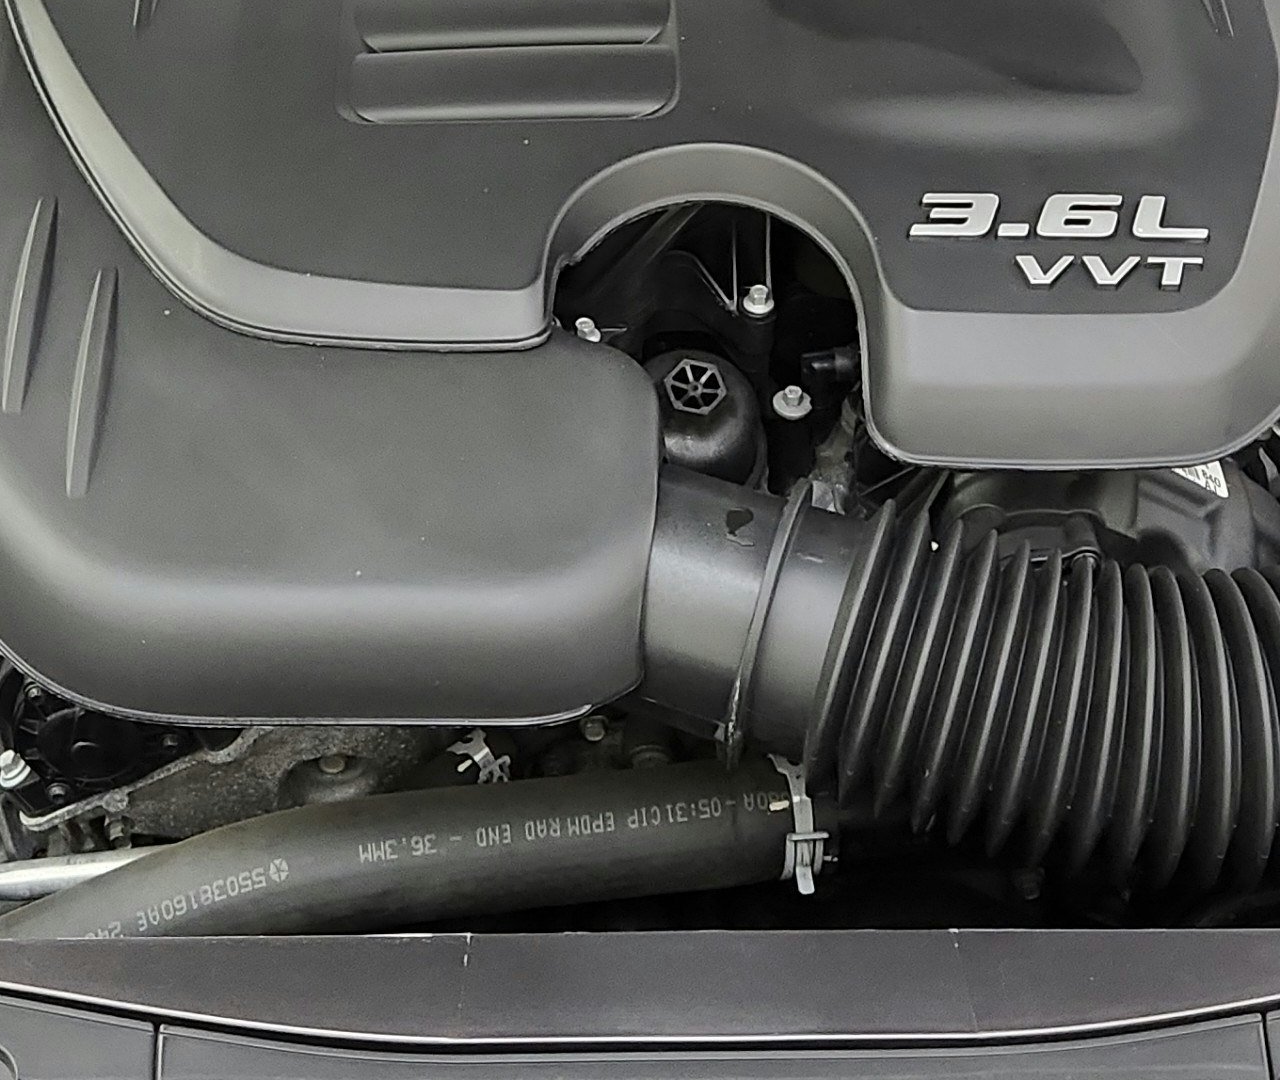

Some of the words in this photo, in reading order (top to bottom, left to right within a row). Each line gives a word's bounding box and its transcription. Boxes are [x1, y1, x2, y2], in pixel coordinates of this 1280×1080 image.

[910, 193, 1209, 240] 3.6L
[1015, 255, 1204, 290] VVT
[476, 825, 511, 847] END
[524, 816, 560, 841] RAD
[566, 811, 614, 837] EPDM
[359, 833, 437, 863] 36.3MM
[136, 867, 266, 932] 55038160AE
